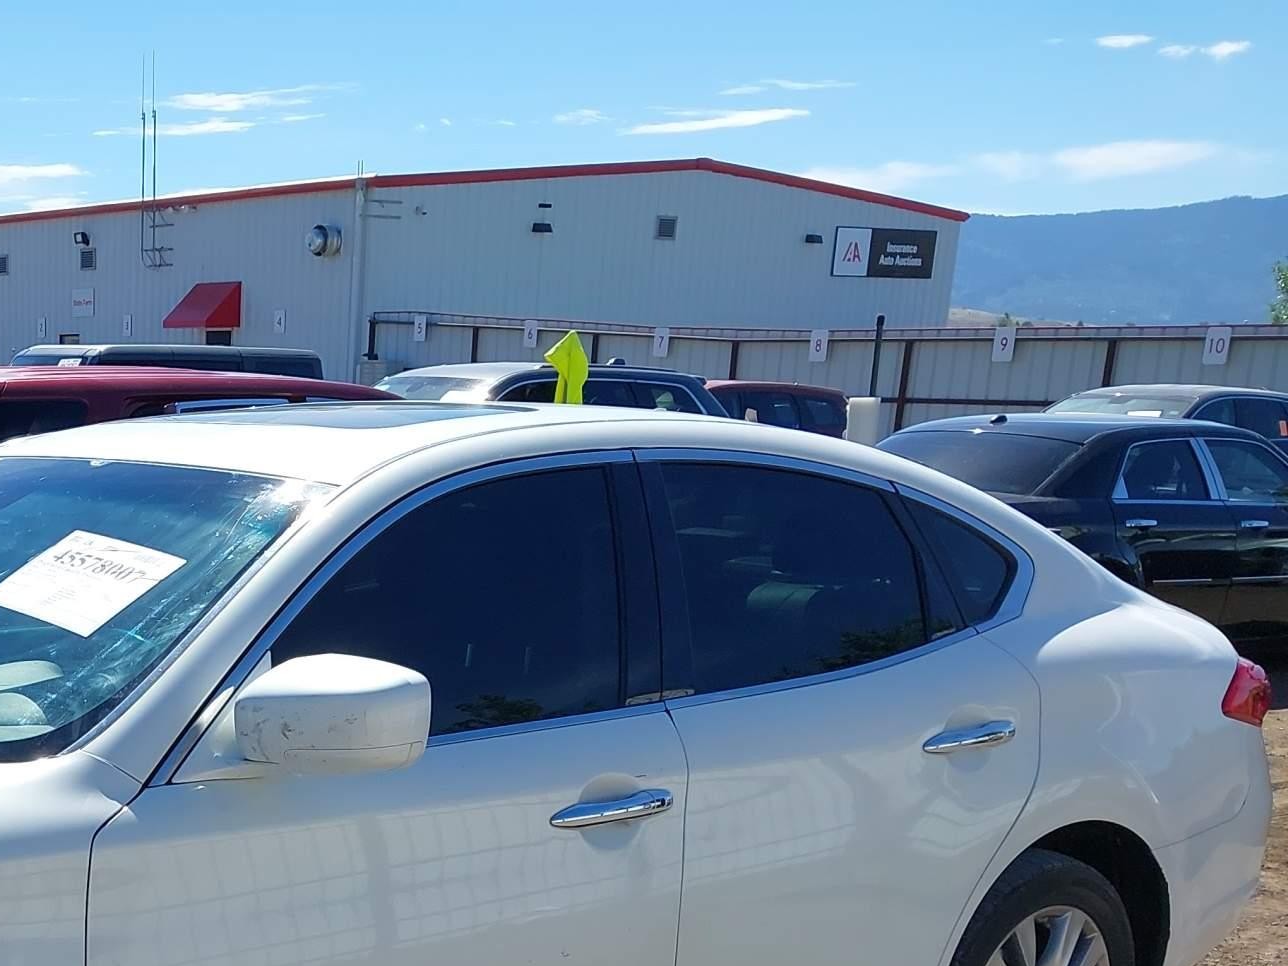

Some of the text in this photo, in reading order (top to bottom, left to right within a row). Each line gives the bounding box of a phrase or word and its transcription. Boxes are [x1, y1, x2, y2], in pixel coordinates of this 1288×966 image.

[886, 241, 918, 254] Insurance
[878, 254, 923, 267] Auto Auctions
[417, 322, 423, 335] 5
[527, 327, 534, 340] 6
[658, 335, 665, 349] 7
[815, 339, 822, 353] 8
[1000, 336, 1009, 351] 9
[1209, 338, 1225, 354] 10
